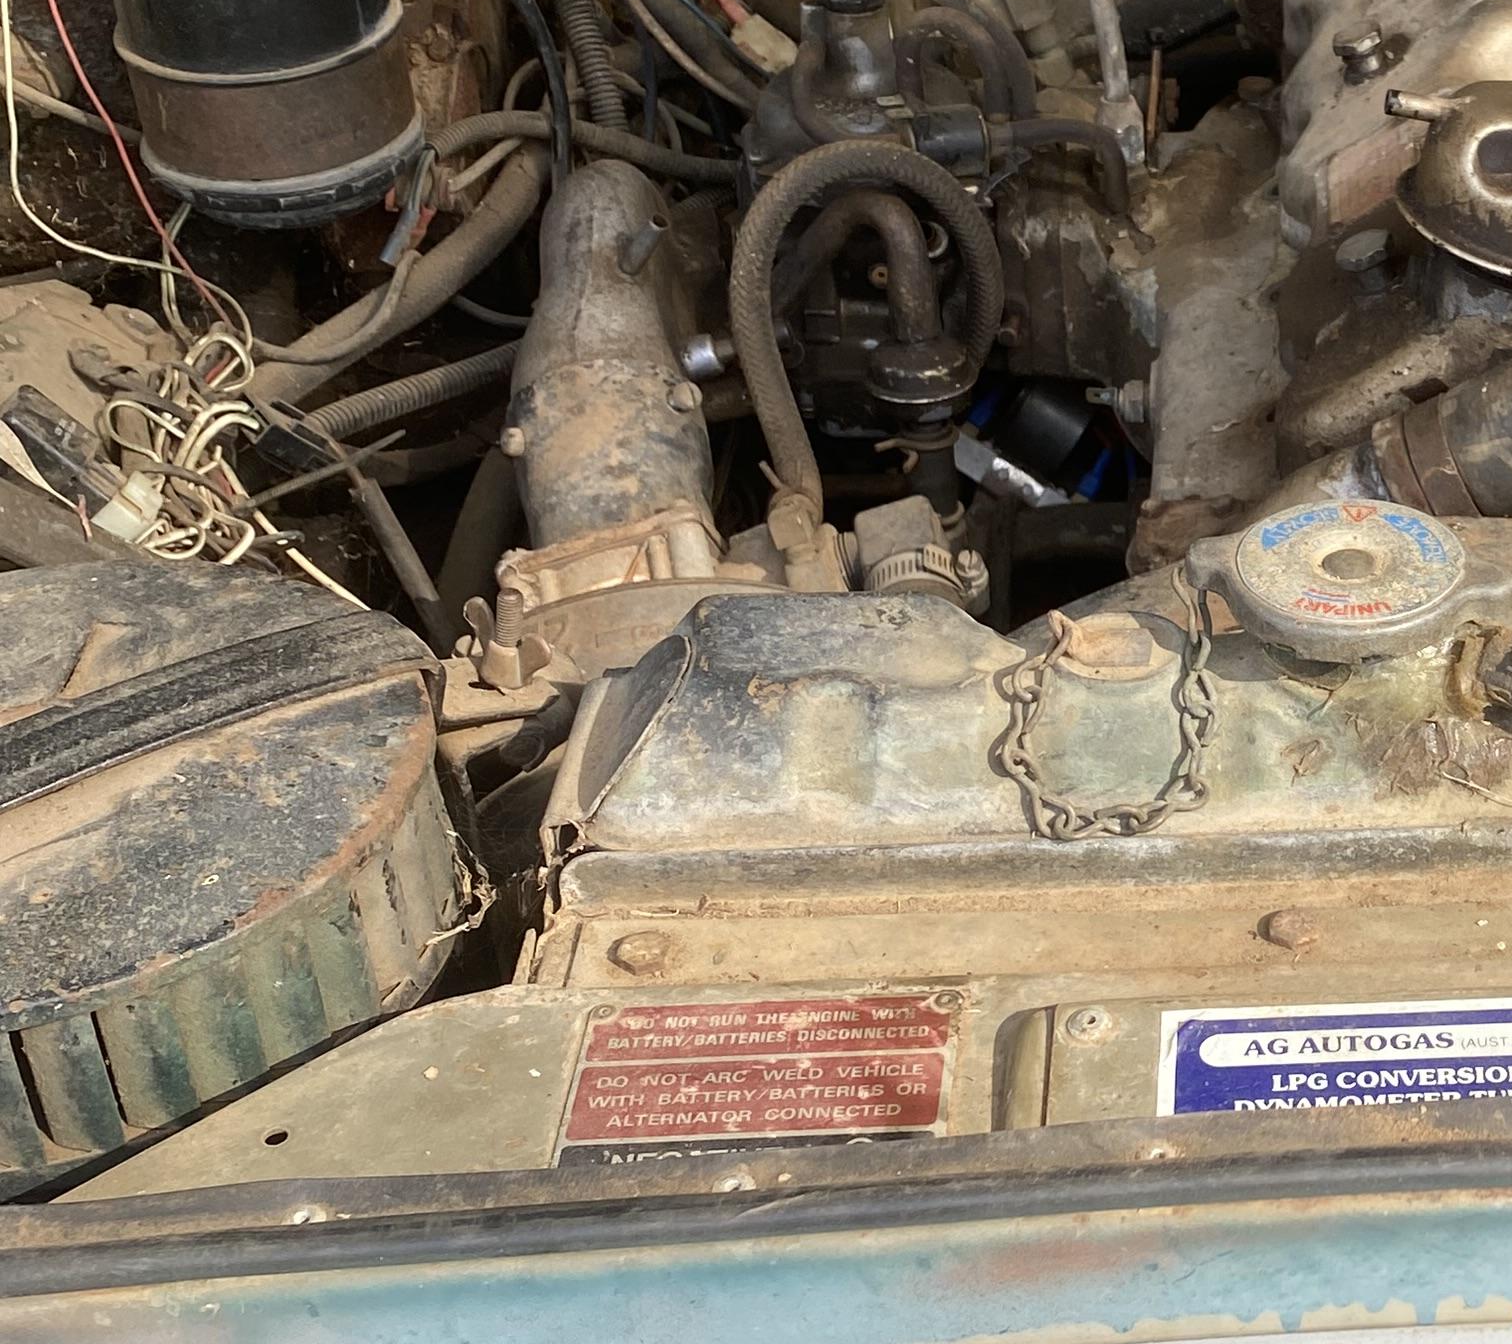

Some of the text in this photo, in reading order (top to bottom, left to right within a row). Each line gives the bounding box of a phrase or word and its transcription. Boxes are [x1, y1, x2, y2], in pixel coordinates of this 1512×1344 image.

[664, 1015, 700, 1028] NOT
[708, 1013, 747, 1026] RUN
[753, 1012, 788, 1025] THE
[606, 1024, 930, 1049] BATTERY/BATTERIES DISCONNECTED
[1244, 1038, 1289, 1057] AG
[1298, 1032, 1455, 1054] AUTOGAS
[596, 1063, 924, 1088] DO NOT ARC WELD VEHICLE
[1272, 1071, 1329, 1092] LPG
[586, 1083, 927, 1108] WITH BATTERY/BATTERIES OR
[606, 1103, 902, 1127] ALTERNATOR CONNECTED
